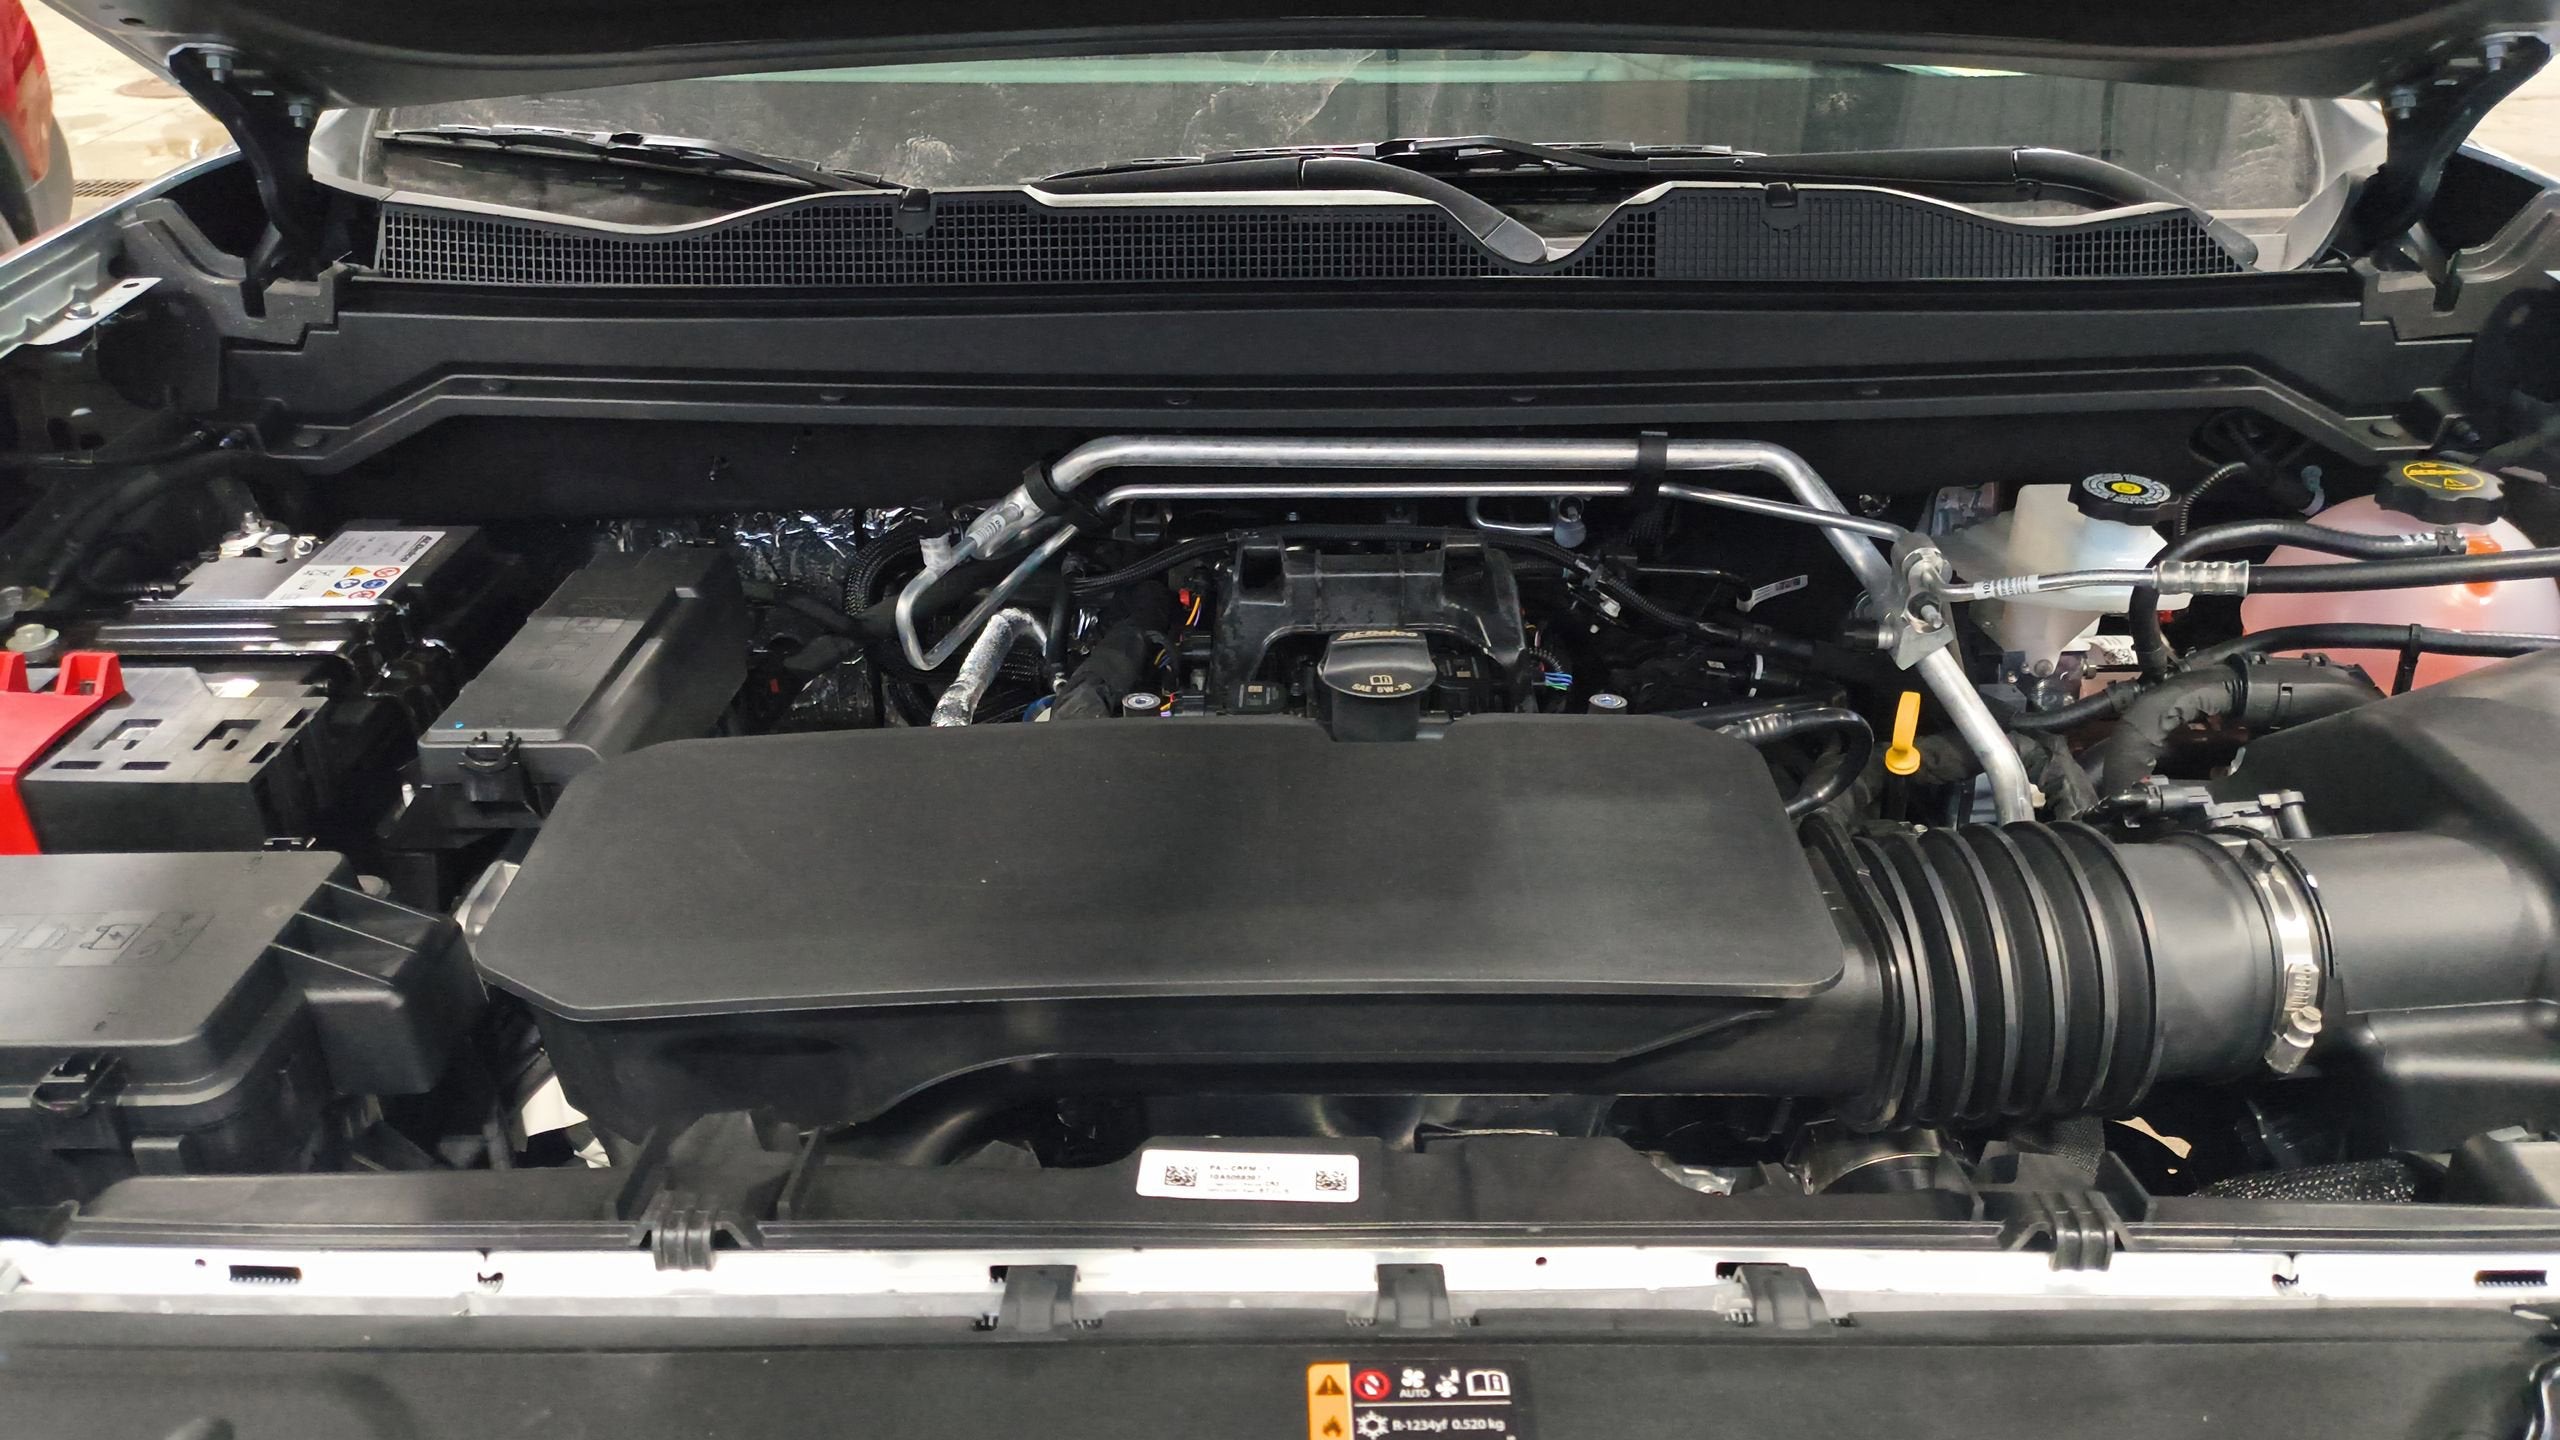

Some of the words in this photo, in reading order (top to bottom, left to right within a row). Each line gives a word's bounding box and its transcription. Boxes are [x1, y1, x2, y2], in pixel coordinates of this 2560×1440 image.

[1352, 683, 1372, 692] SAE
[1399, 1389, 1431, 1398] AUTO
[1392, 1418, 1448, 1432] R-1234yf
[1452, 1419, 1487, 1430] 0.520
[1487, 1418, 1506, 1431] kg
